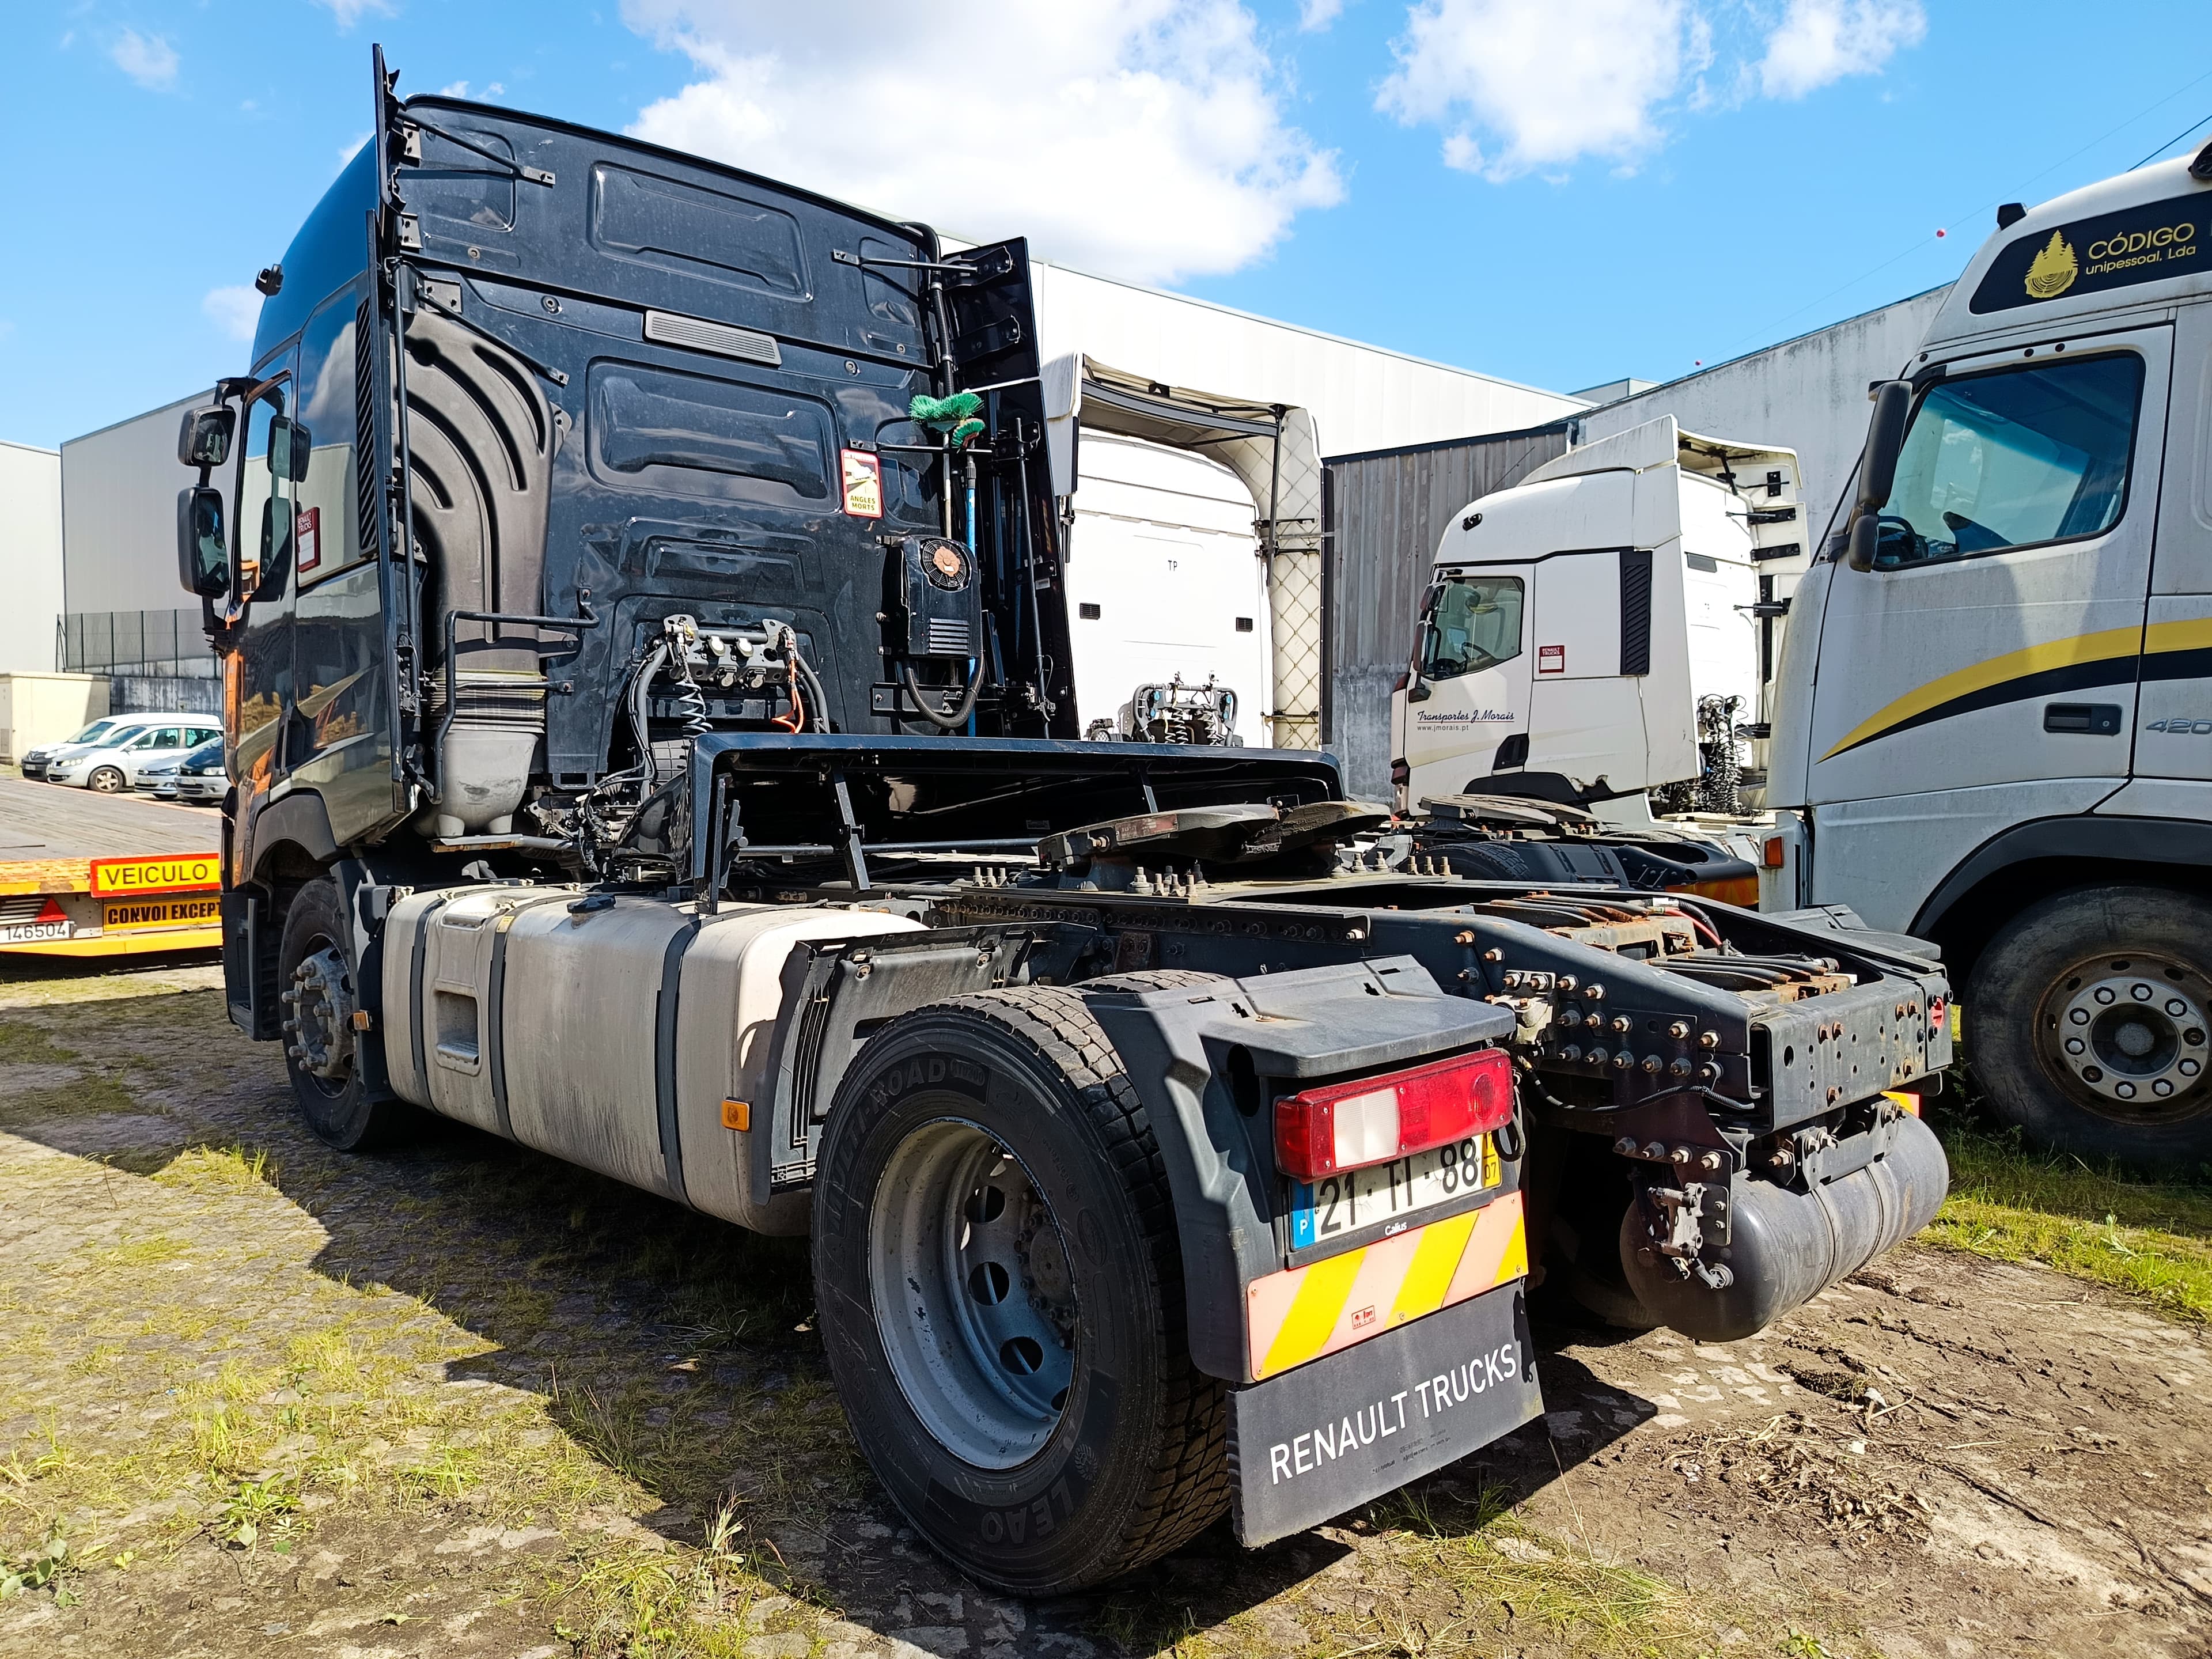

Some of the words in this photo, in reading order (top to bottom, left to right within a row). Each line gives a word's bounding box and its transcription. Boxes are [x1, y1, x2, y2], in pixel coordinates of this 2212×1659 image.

[2088, 223, 2195, 259] CÓDIGO
[2168, 245, 2196, 259] Lda
[850, 495, 876, 504] ANGLES
[852, 503, 875, 511] MORTS
[1417, 710, 1469, 724] Transportes
[1471, 710, 1479, 724] J.
[1481, 710, 1514, 720] Morais
[2146, 718, 2212, 734] 420
[105, 863, 208, 885] VEICULO
[108, 906, 167, 925] CONVOI
[5, 922, 66, 940] 146504
[1484, 1161, 1497, 1179] 07
[1300, 1219, 1308, 1235] P
[1270, 1391, 1408, 1485] RENAULT
[1415, 1343, 1517, 1418] TRUCKS
